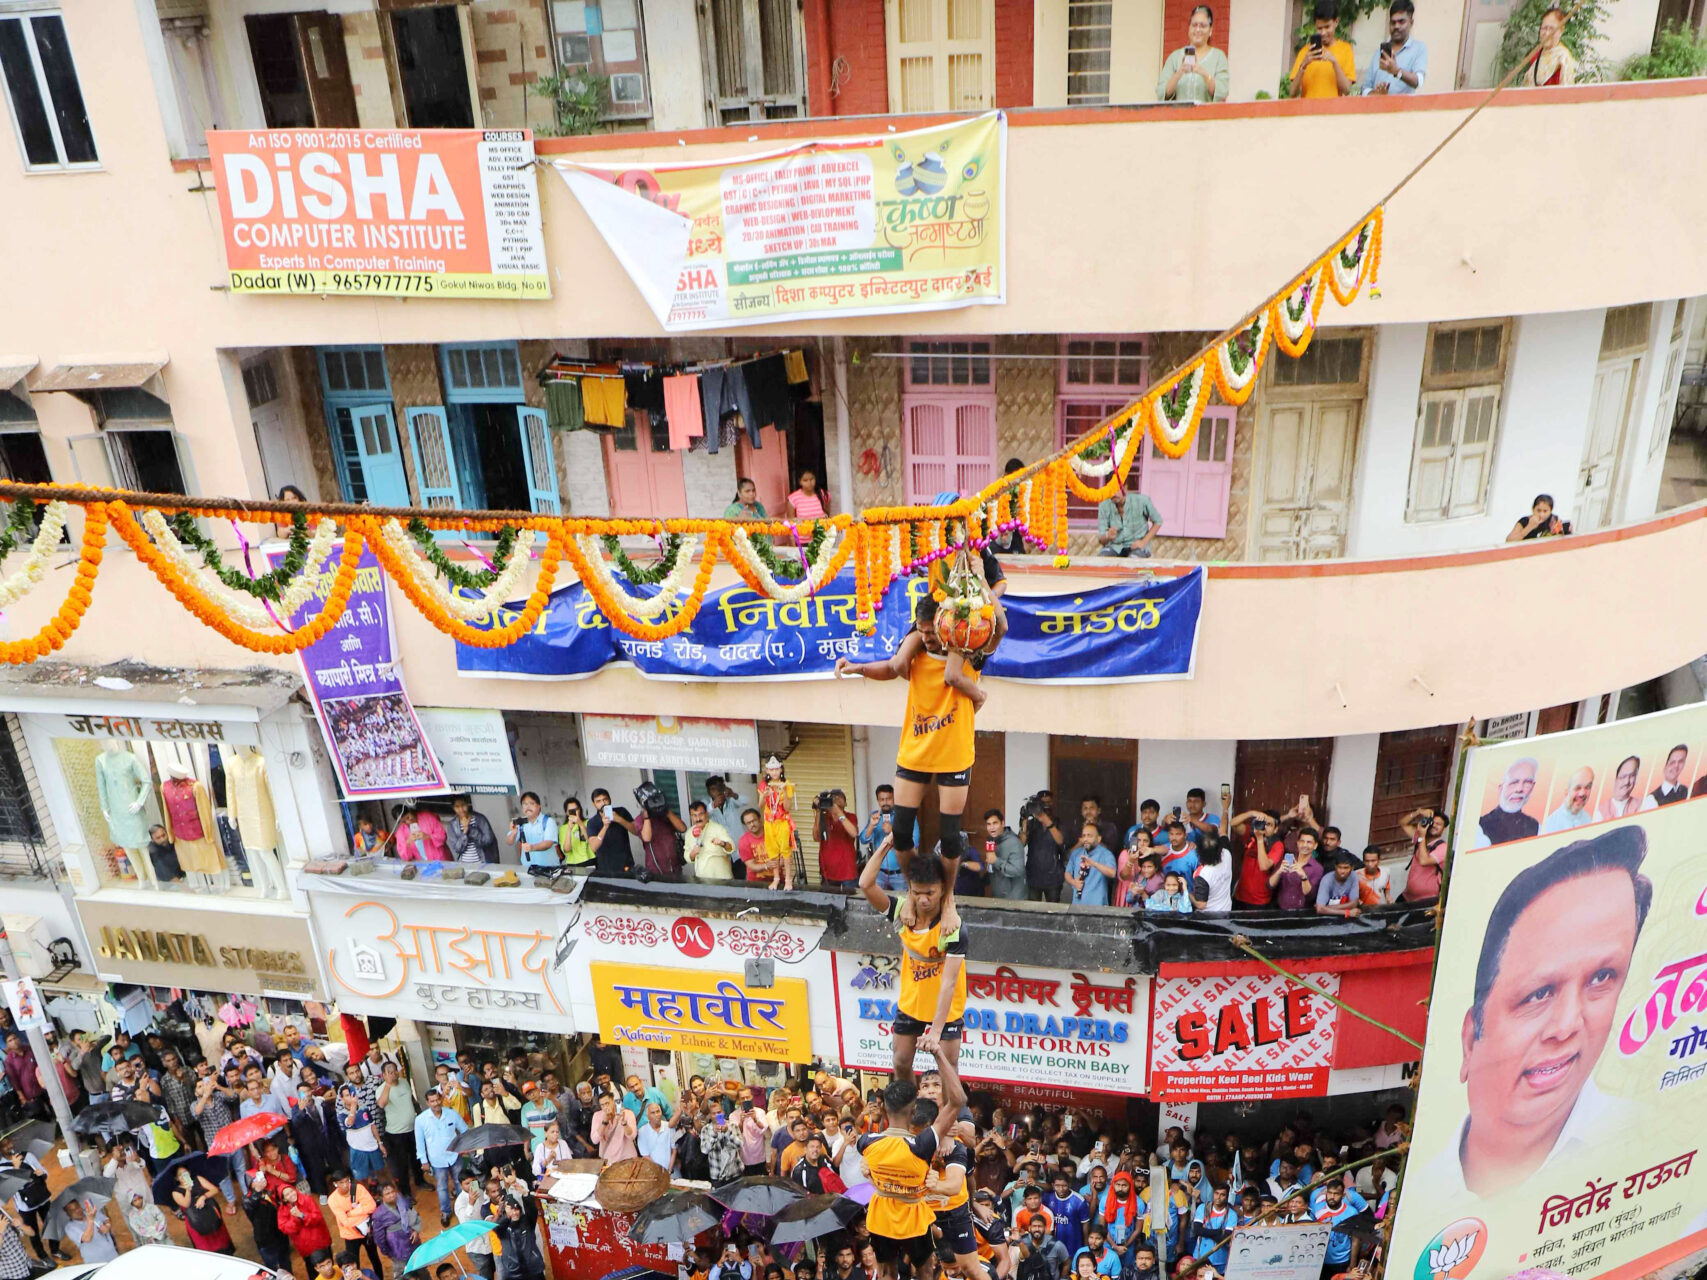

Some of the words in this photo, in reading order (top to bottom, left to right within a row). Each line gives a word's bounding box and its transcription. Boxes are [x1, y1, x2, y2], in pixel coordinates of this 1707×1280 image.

[249, 134, 266, 148] An
[269, 134, 291, 148] ISO
[296, 134, 361, 149] 9001:2015
[364, 133, 422, 150] Certified
[484, 132, 524, 141] COURSES
[794, 166, 816, 178] PRIME
[222, 152, 465, 221] DiSHA
[771, 183, 798, 196] PYTHON
[725, 203, 757, 215] GRAPHIC
[758, 198, 796, 211] DESIGNING
[801, 195, 826, 206] DIGITAL
[828, 190, 872, 203] MARKETING
[233, 223, 356, 248] COMPUTER
[365, 225, 467, 250] INSTITUTE
[765, 225, 806, 239] ANIMATION
[823, 220, 859, 232] TRAINING
[764, 242, 792, 254] SKETCH
[821, 237, 837, 247] MAX
[260, 254, 305, 270] Experts
[308, 255, 321, 269] In
[325, 256, 387, 271] Computer
[393, 256, 446, 273] Training
[231, 273, 282, 289] Dadar
[287, 272, 316, 293] (W)
[333, 273, 433, 292] 9657977775
[440, 278, 467, 290] Gokul
[468, 279, 495, 291] Niwas
[497, 279, 519, 292] Bldg.
[522, 281, 535, 291] No
[733, 291, 770, 311] सौजन्य
[775, 284, 805, 304] दिशा
[931, 276, 962, 292] दादर
[1035, 597, 1165, 635] मंडळ
[340, 634, 363, 652] आणि
[719, 643, 762, 661] दादर
[816, 635, 861, 662] मुंबई
[315, 659, 354, 688] व्यापारी
[350, 658, 377, 685] मित्र
[64, 714, 145, 738] जनता
[598, 751, 626, 762] OFFICE
[627, 752, 640, 762] OF
[641, 753, 658, 763] THE
[659, 755, 701, 767] ARBITRAL
[702, 756, 748, 768] TRIBUNAL
[97, 925, 217, 968] JANATA
[220, 945, 308, 974] STORES
[673, 924, 711, 951] M
[329, 901, 564, 1016] आझाद
[613, 980, 786, 1030] महावीर
[1070, 972, 1137, 1018] ड्रेपर्स
[1004, 1010, 1129, 1044] DRAPERS
[1175, 986, 1318, 1061] SALE
[613, 1024, 673, 1044] Mahavir
[680, 1034, 716, 1050] Ethnic
[718, 1038, 730, 1050] &
[731, 1039, 763, 1053] Men's
[763, 1043, 790, 1056] Wear
[982, 1031, 1112, 1058] UNIFORMS
[978, 1049, 1007, 1064] FOR
[1010, 1053, 1043, 1067] NEW
[1046, 1056, 1094, 1073] BORN
[1097, 1060, 1132, 1075] BABY
[985, 1064, 1017, 1073] ELIGIBLE
[1029, 1066, 1063, 1076] COLLECT
[1265, 1072, 1286, 1083] Kids
[1288, 1071, 1314, 1083] Wear
[966, 1081, 1007, 1092] YOU'RE
[1013, 1086, 1078, 1100] BEAUTIFUL
[1165, 1109, 1191, 1124] SALE
[1537, 1177, 1618, 1235] जितेंद्र
[1622, 1149, 1698, 1200] राऊत
[1533, 1238, 1566, 1258] सचिव,
[1571, 1221, 1607, 1242] भाजपा
[1608, 1204, 1644, 1231] (मुंबई)
[1571, 1236, 1606, 1259] अखिल
[1610, 1220, 1646, 1243] भारतीय
